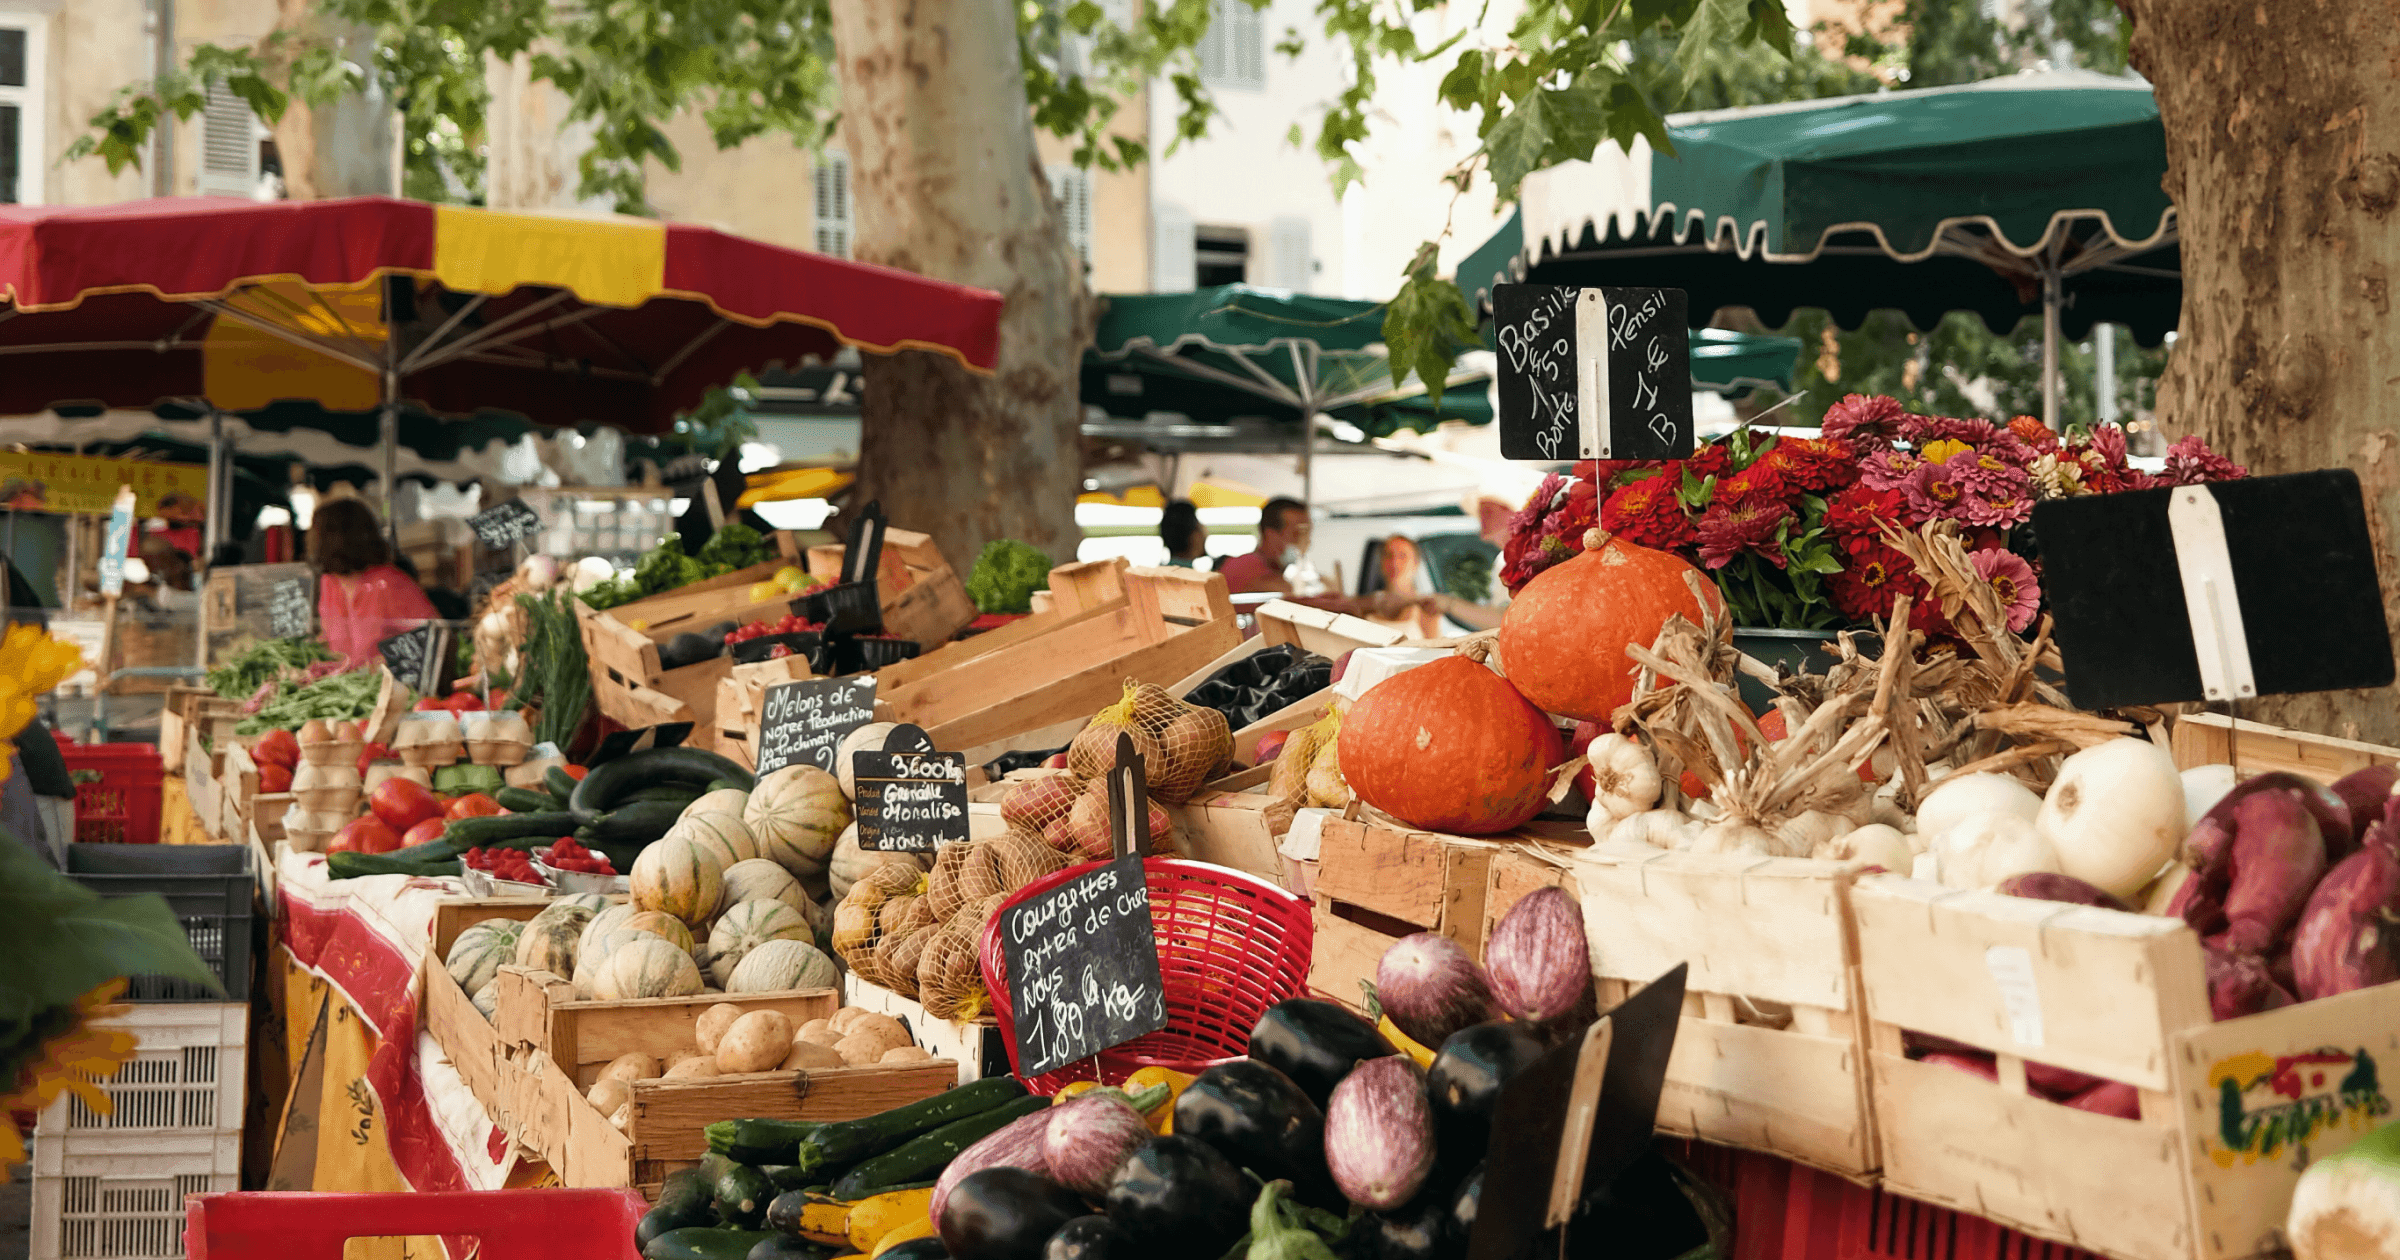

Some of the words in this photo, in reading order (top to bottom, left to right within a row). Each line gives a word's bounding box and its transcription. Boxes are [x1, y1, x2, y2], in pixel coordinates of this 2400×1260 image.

[1648, 413, 1677, 446] B
[767, 685, 824, 723] Melons
[830, 685, 857, 706] de
[806, 707, 873, 730] Production
[882, 801, 962, 822] Monalisa
[1012, 870, 1118, 944] Courgettes
[1084, 906, 1112, 934] de
